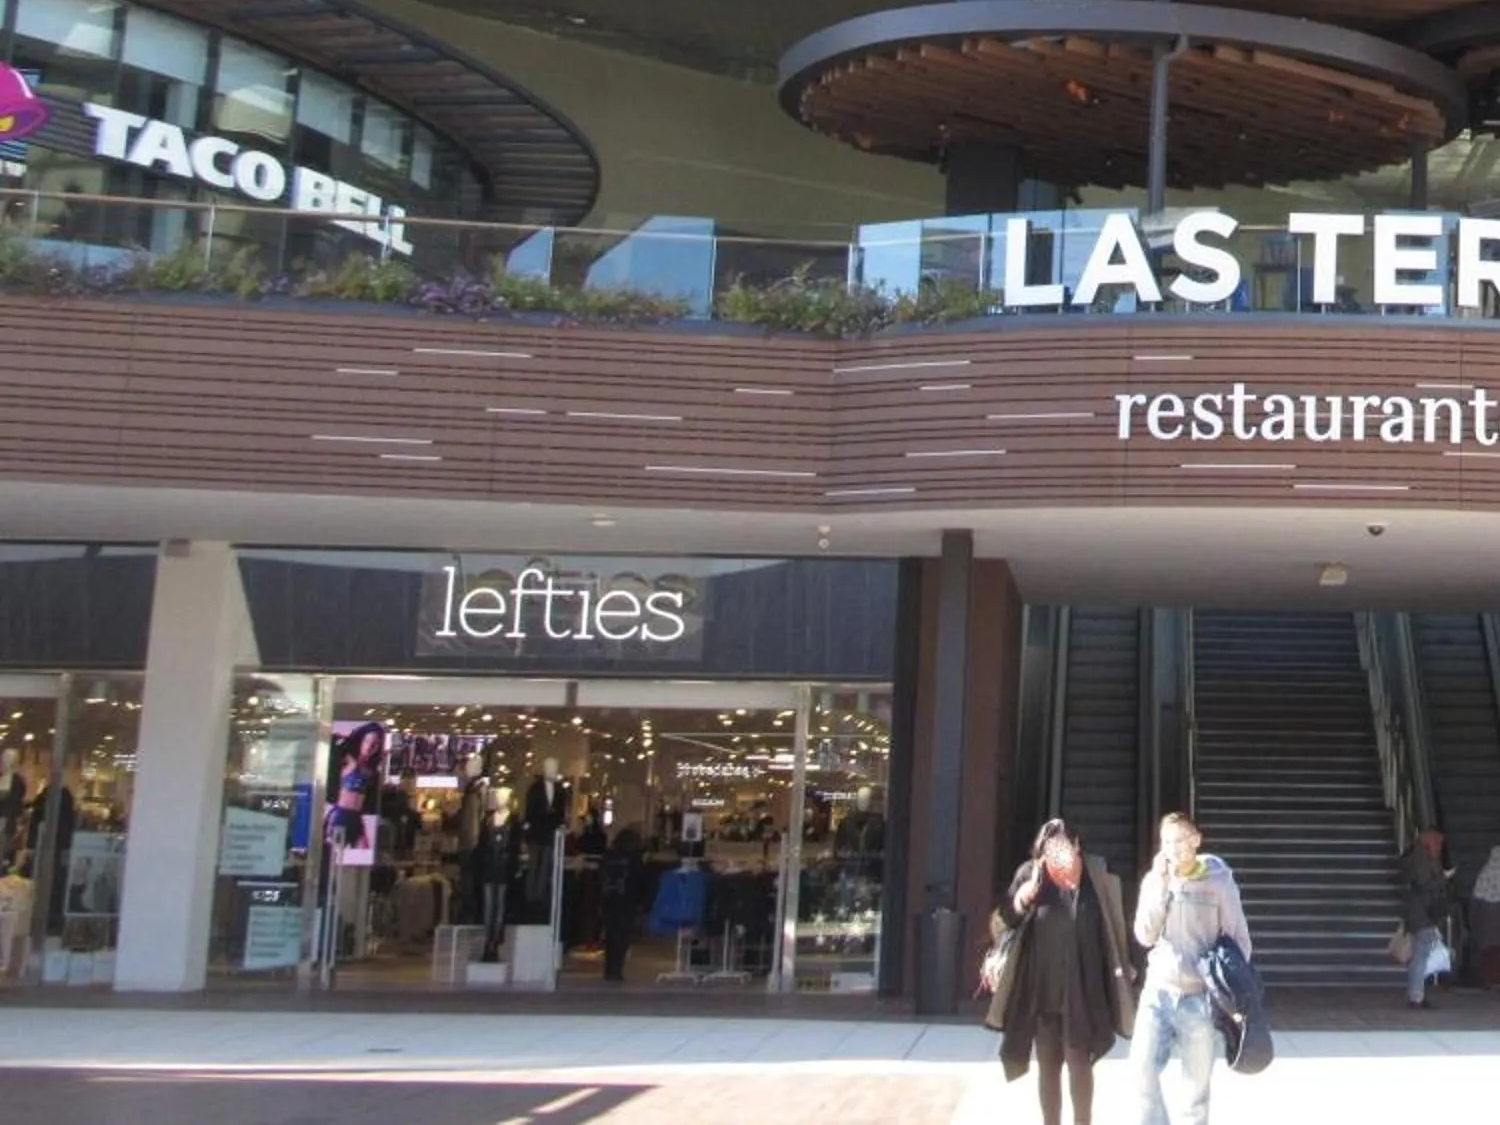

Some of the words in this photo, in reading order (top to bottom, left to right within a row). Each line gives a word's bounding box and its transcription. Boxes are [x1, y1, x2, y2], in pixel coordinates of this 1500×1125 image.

[86, 103, 286, 202] TACO
[291, 165, 414, 256] BELL
[1003, 209, 1241, 308] LAS
[434, 565, 686, 643] lefties
